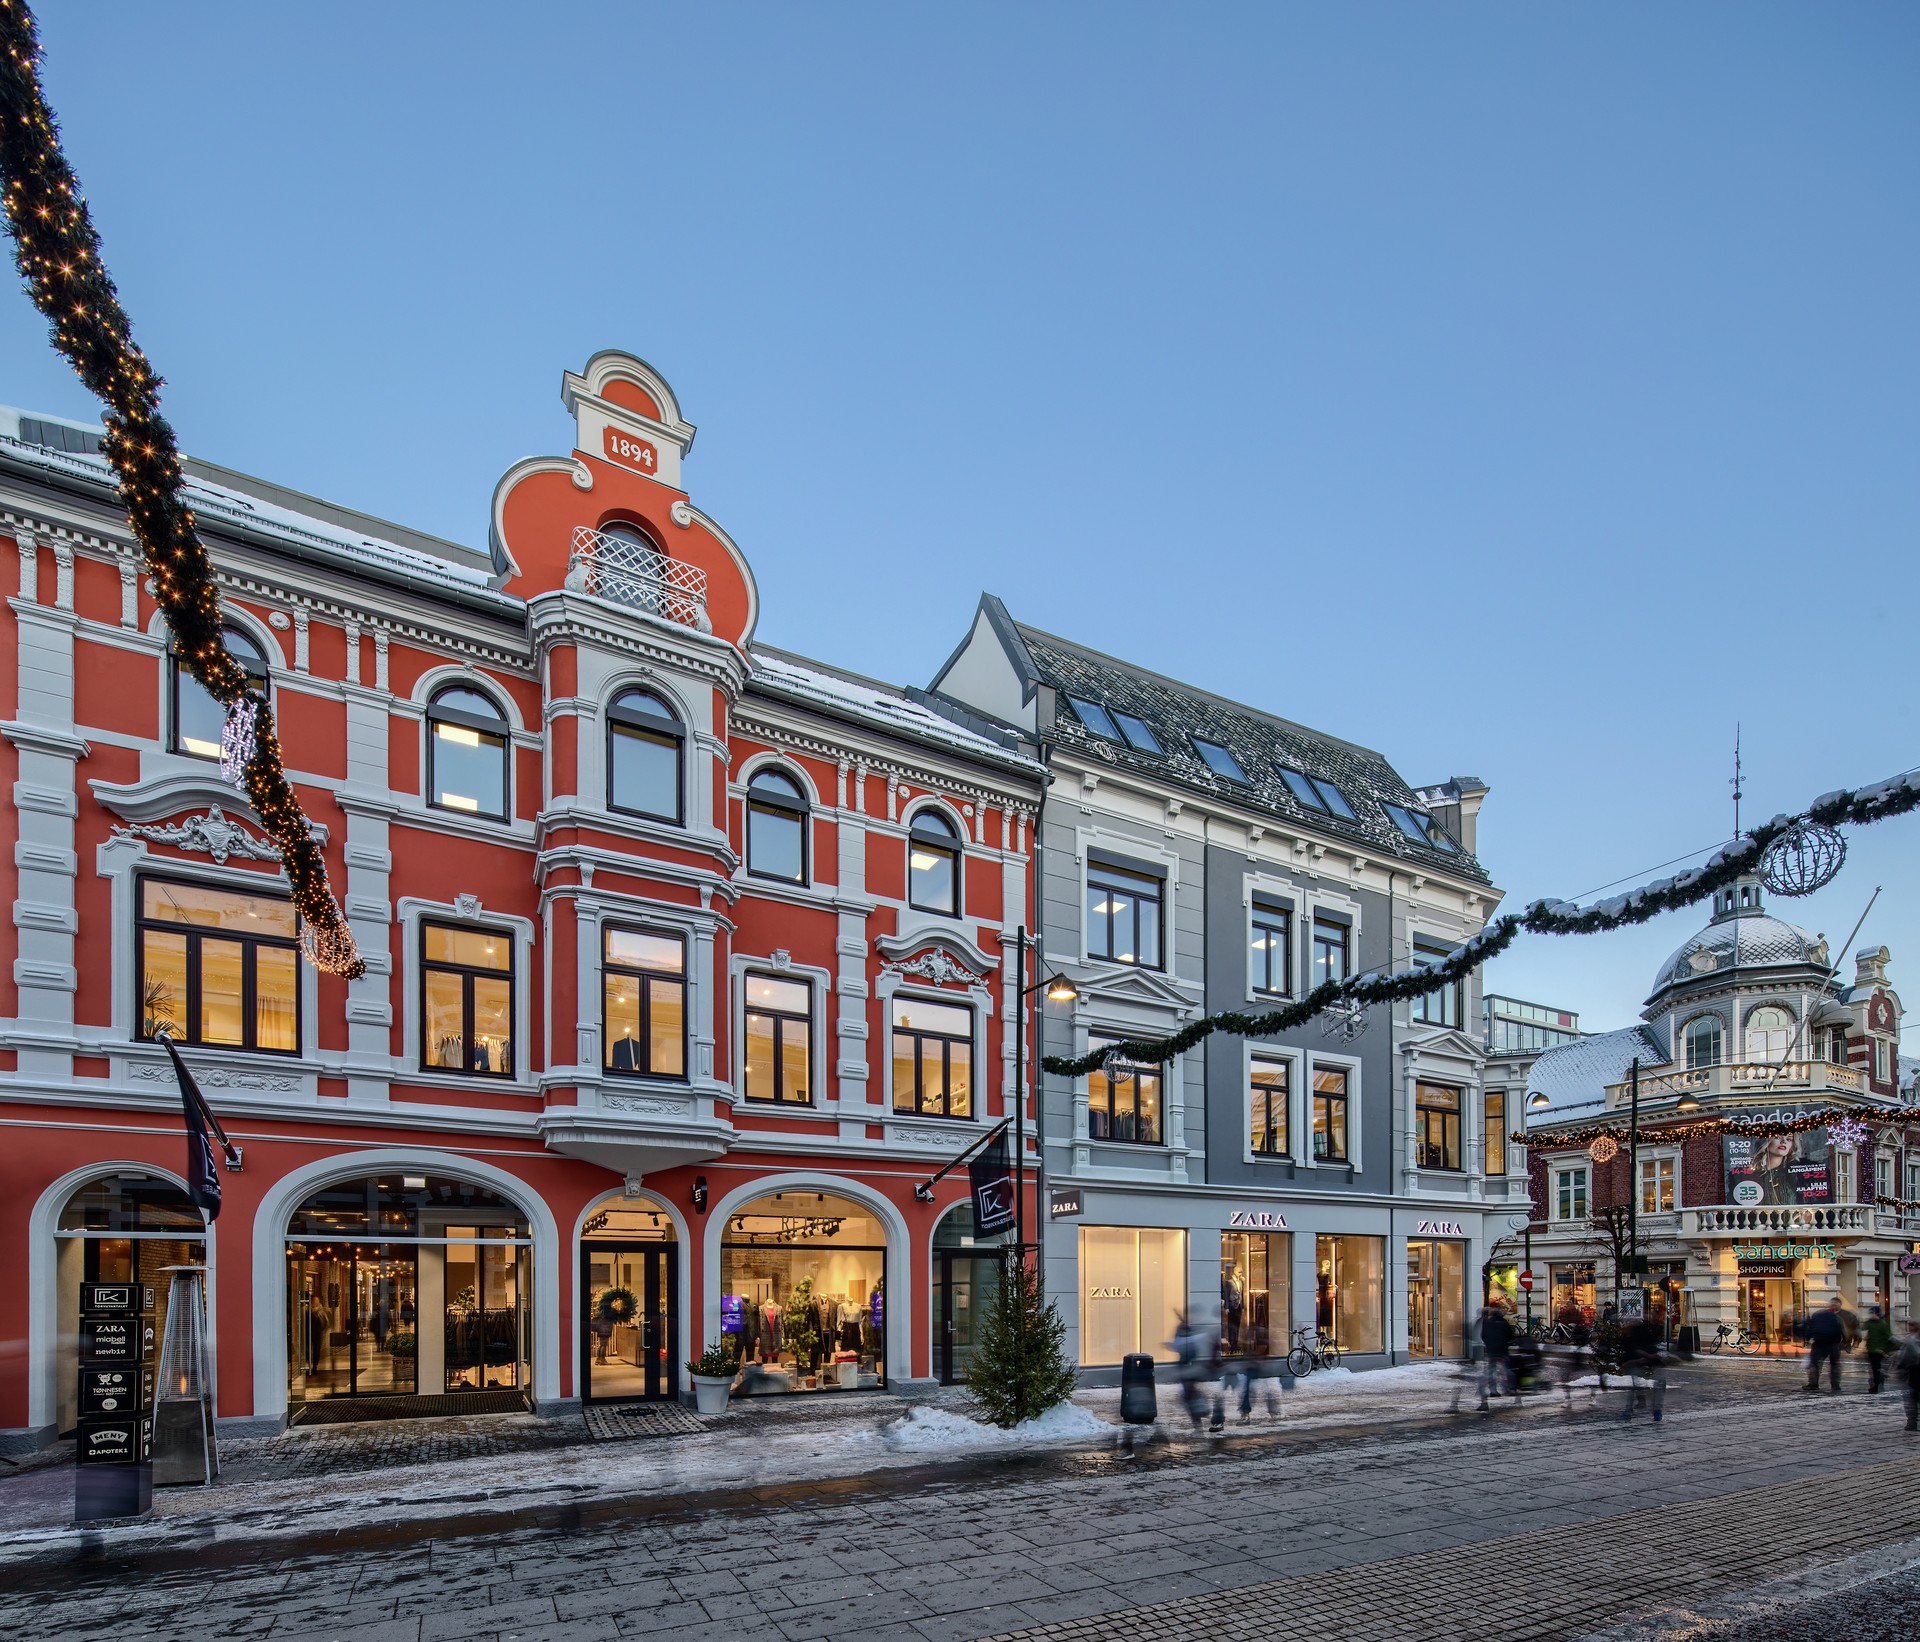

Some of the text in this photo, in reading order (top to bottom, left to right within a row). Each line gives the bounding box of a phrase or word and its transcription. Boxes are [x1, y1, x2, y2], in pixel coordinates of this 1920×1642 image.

[611, 436, 652, 467] 1894
[1788, 1166, 1826, 1174] LANGÅPENT
[1739, 1186, 1758, 1196] 35
[1052, 1202, 1078, 1213] ZARA
[1230, 1211, 1288, 1228] ZARA
[1417, 1220, 1463, 1236] ZARA
[1733, 1240, 1837, 1260] sandens
[1739, 1266, 1785, 1274] SHOPPING
[1090, 1286, 1133, 1298] ZARA
[94, 1433, 124, 1441] MENY
